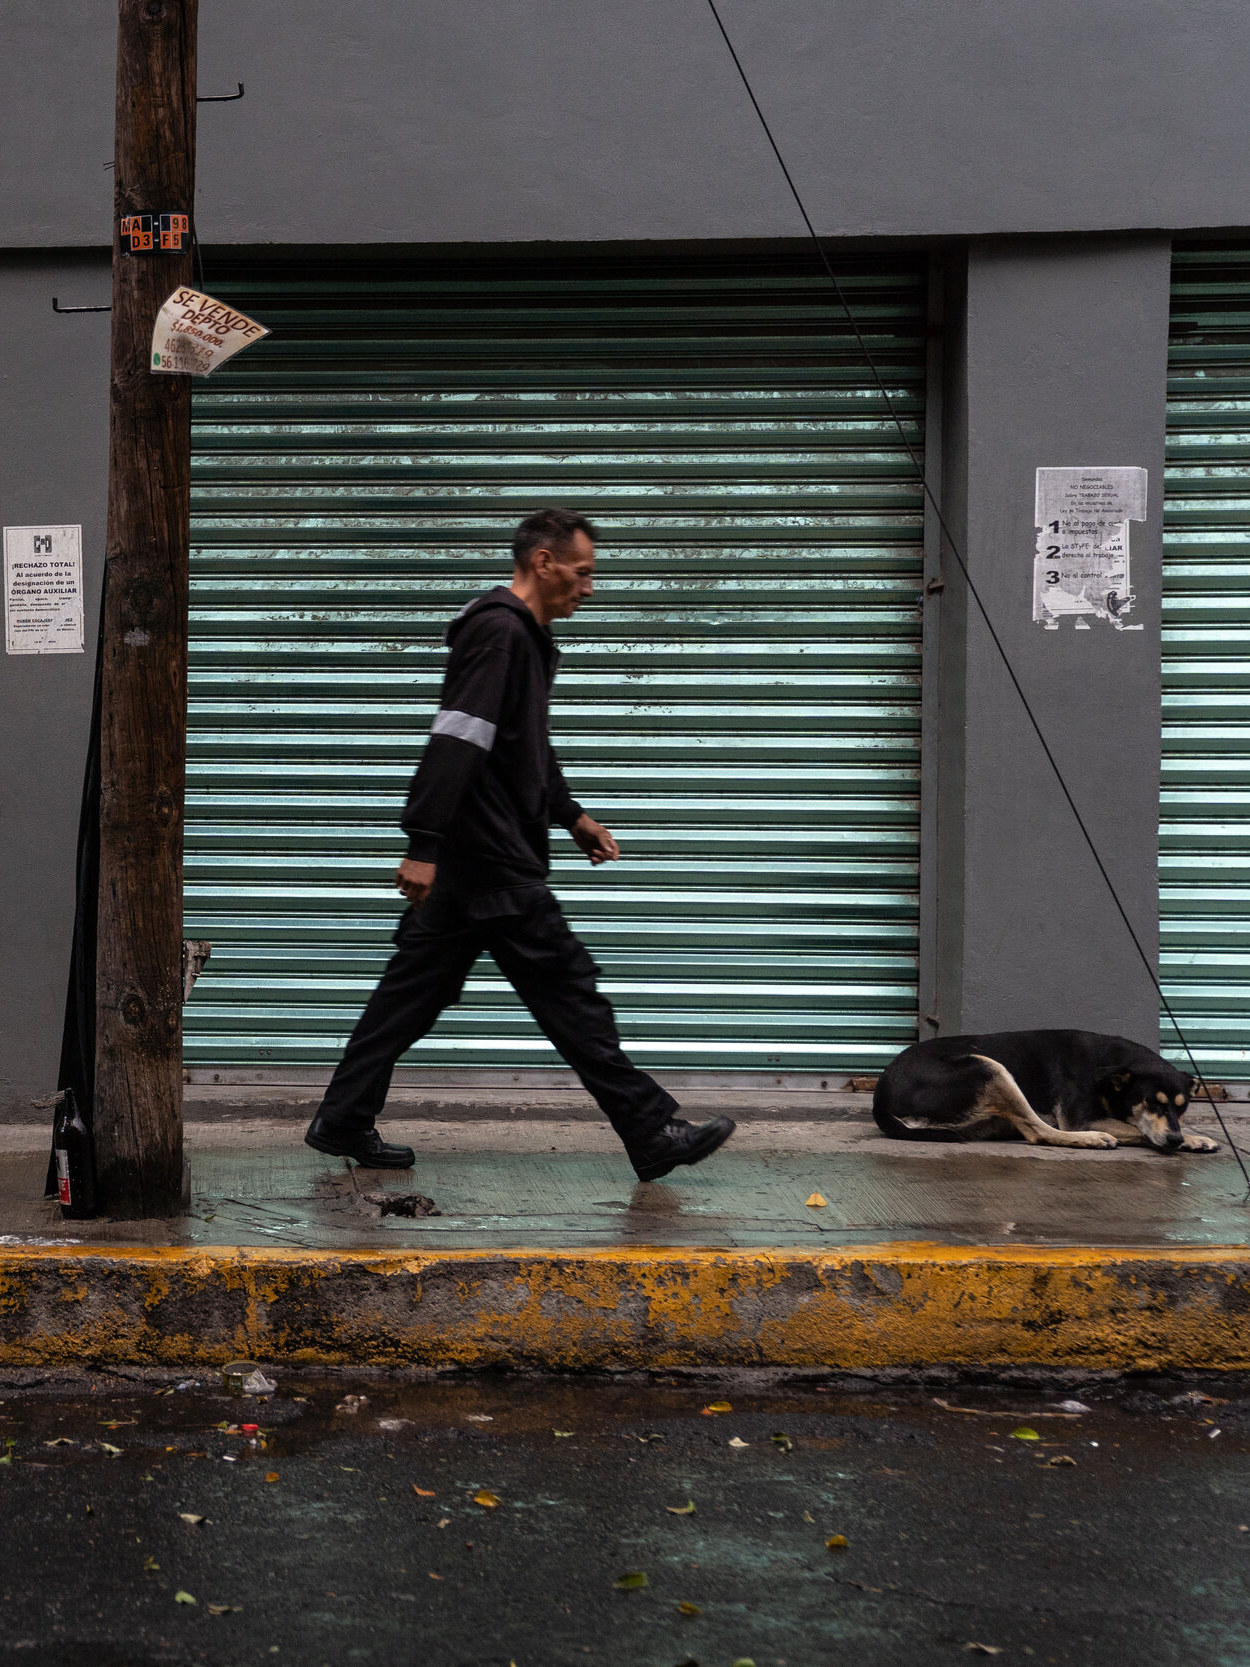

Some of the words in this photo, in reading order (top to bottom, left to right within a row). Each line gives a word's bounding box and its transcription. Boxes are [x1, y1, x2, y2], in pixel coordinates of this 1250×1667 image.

[172, 290, 200, 308] SE
[198, 299, 261, 338] VENDE
[180, 309, 230, 335] DEPTO
[1048, 520, 1060, 534] 1
[1081, 520, 1096, 528] pago
[1045, 545, 1061, 559] 2
[1045, 570, 1061, 584] 3
